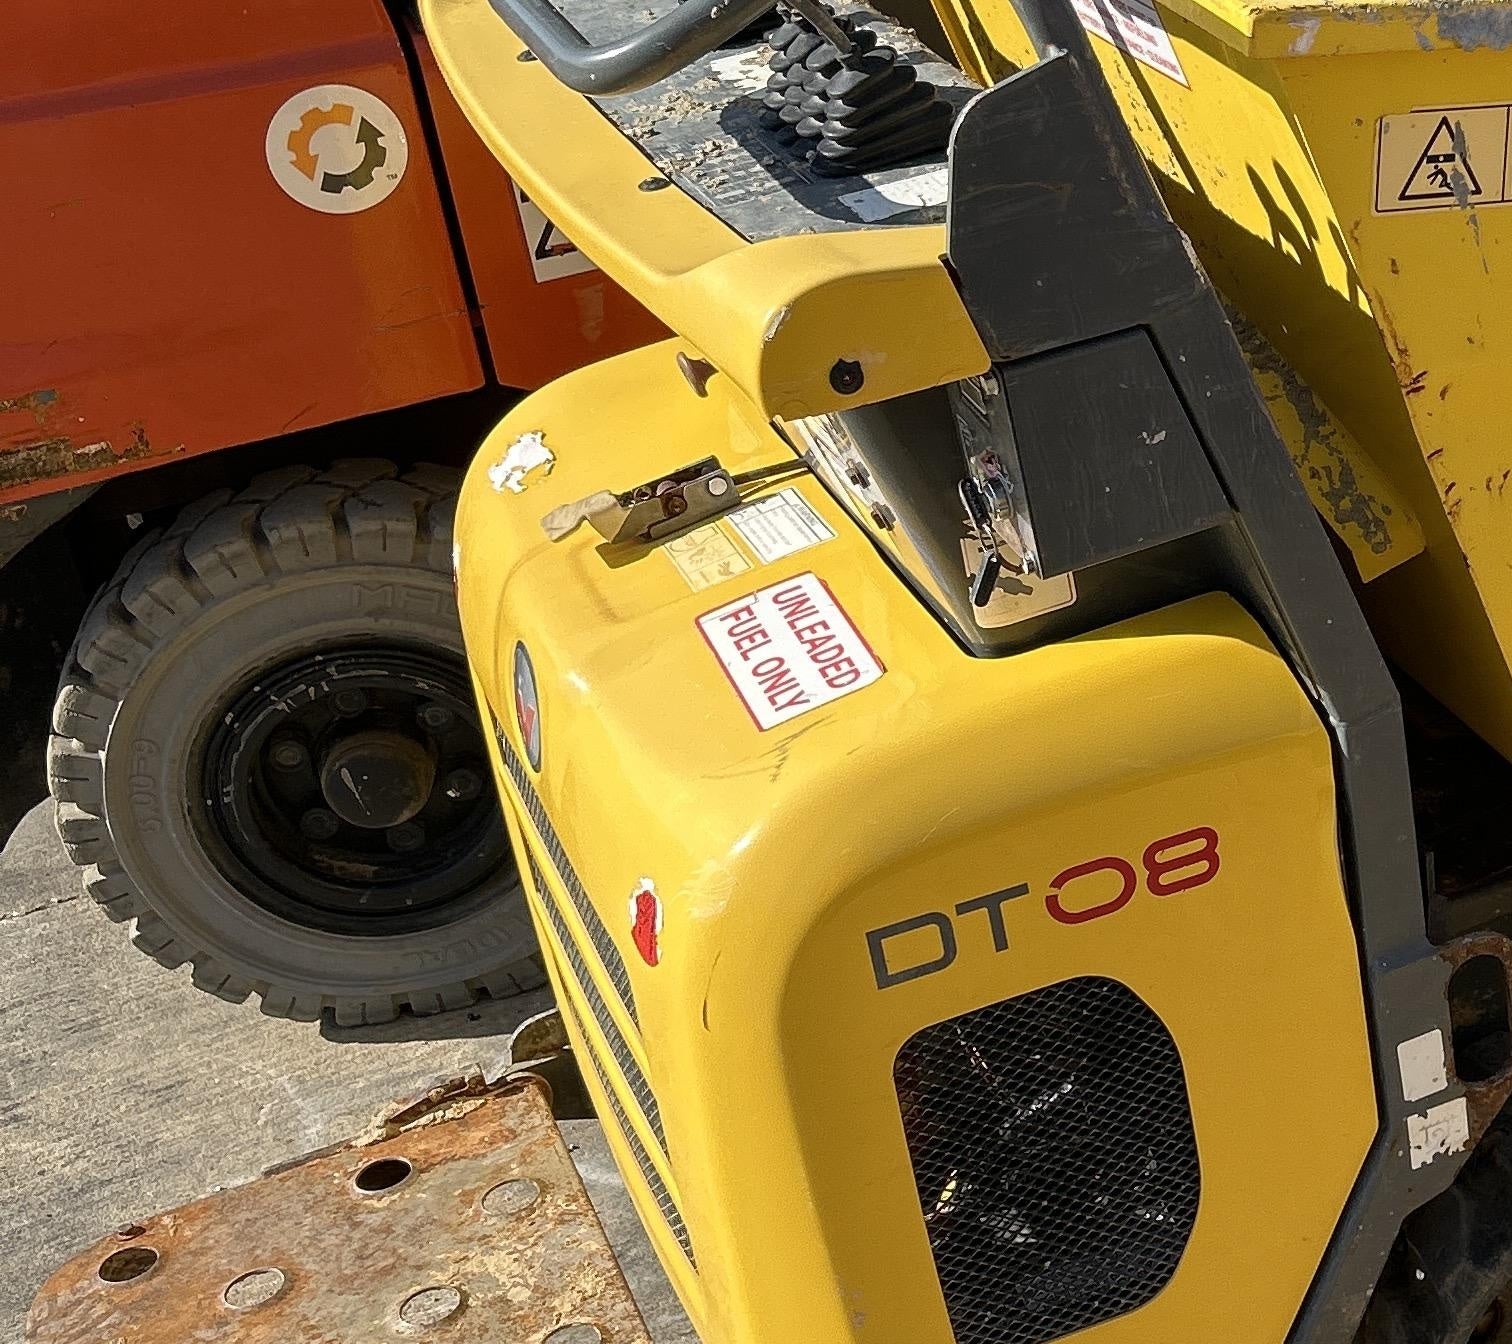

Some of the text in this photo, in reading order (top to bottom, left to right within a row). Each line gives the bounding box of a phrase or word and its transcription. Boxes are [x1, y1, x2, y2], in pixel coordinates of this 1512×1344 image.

[719, 605, 811, 712] FUEL ONLY
[772, 584, 861, 689] UNLEADED
[865, 826, 1221, 991] DT08
